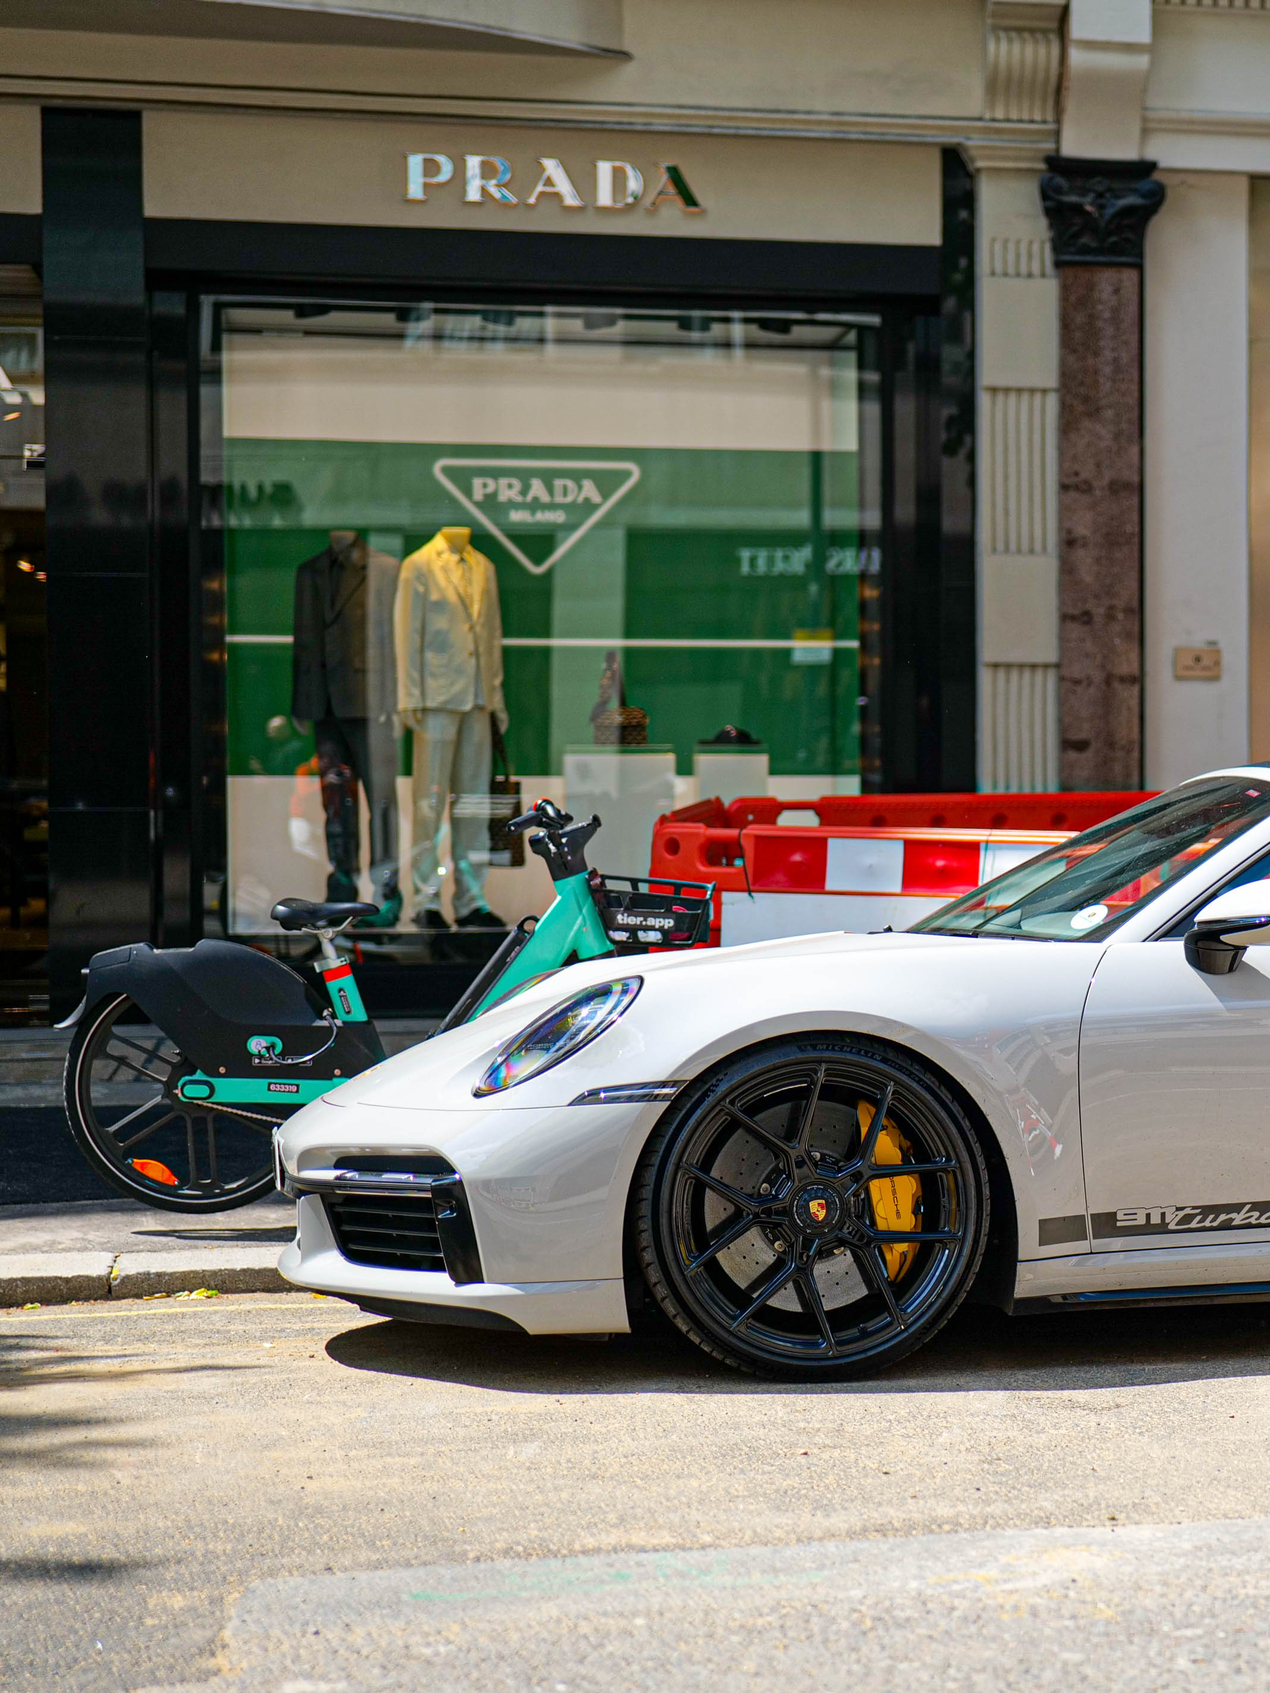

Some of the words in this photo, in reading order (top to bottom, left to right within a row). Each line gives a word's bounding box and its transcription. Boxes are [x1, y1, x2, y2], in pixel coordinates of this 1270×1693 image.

[404, 151, 703, 213] PRADA
[472, 476, 604, 504] PRADA
[509, 509, 567, 524] MILANO
[616, 913, 675, 929] tier.app
[815, 1043, 883, 1062] MICHELIN
[1116, 1205, 1178, 1227] 911
